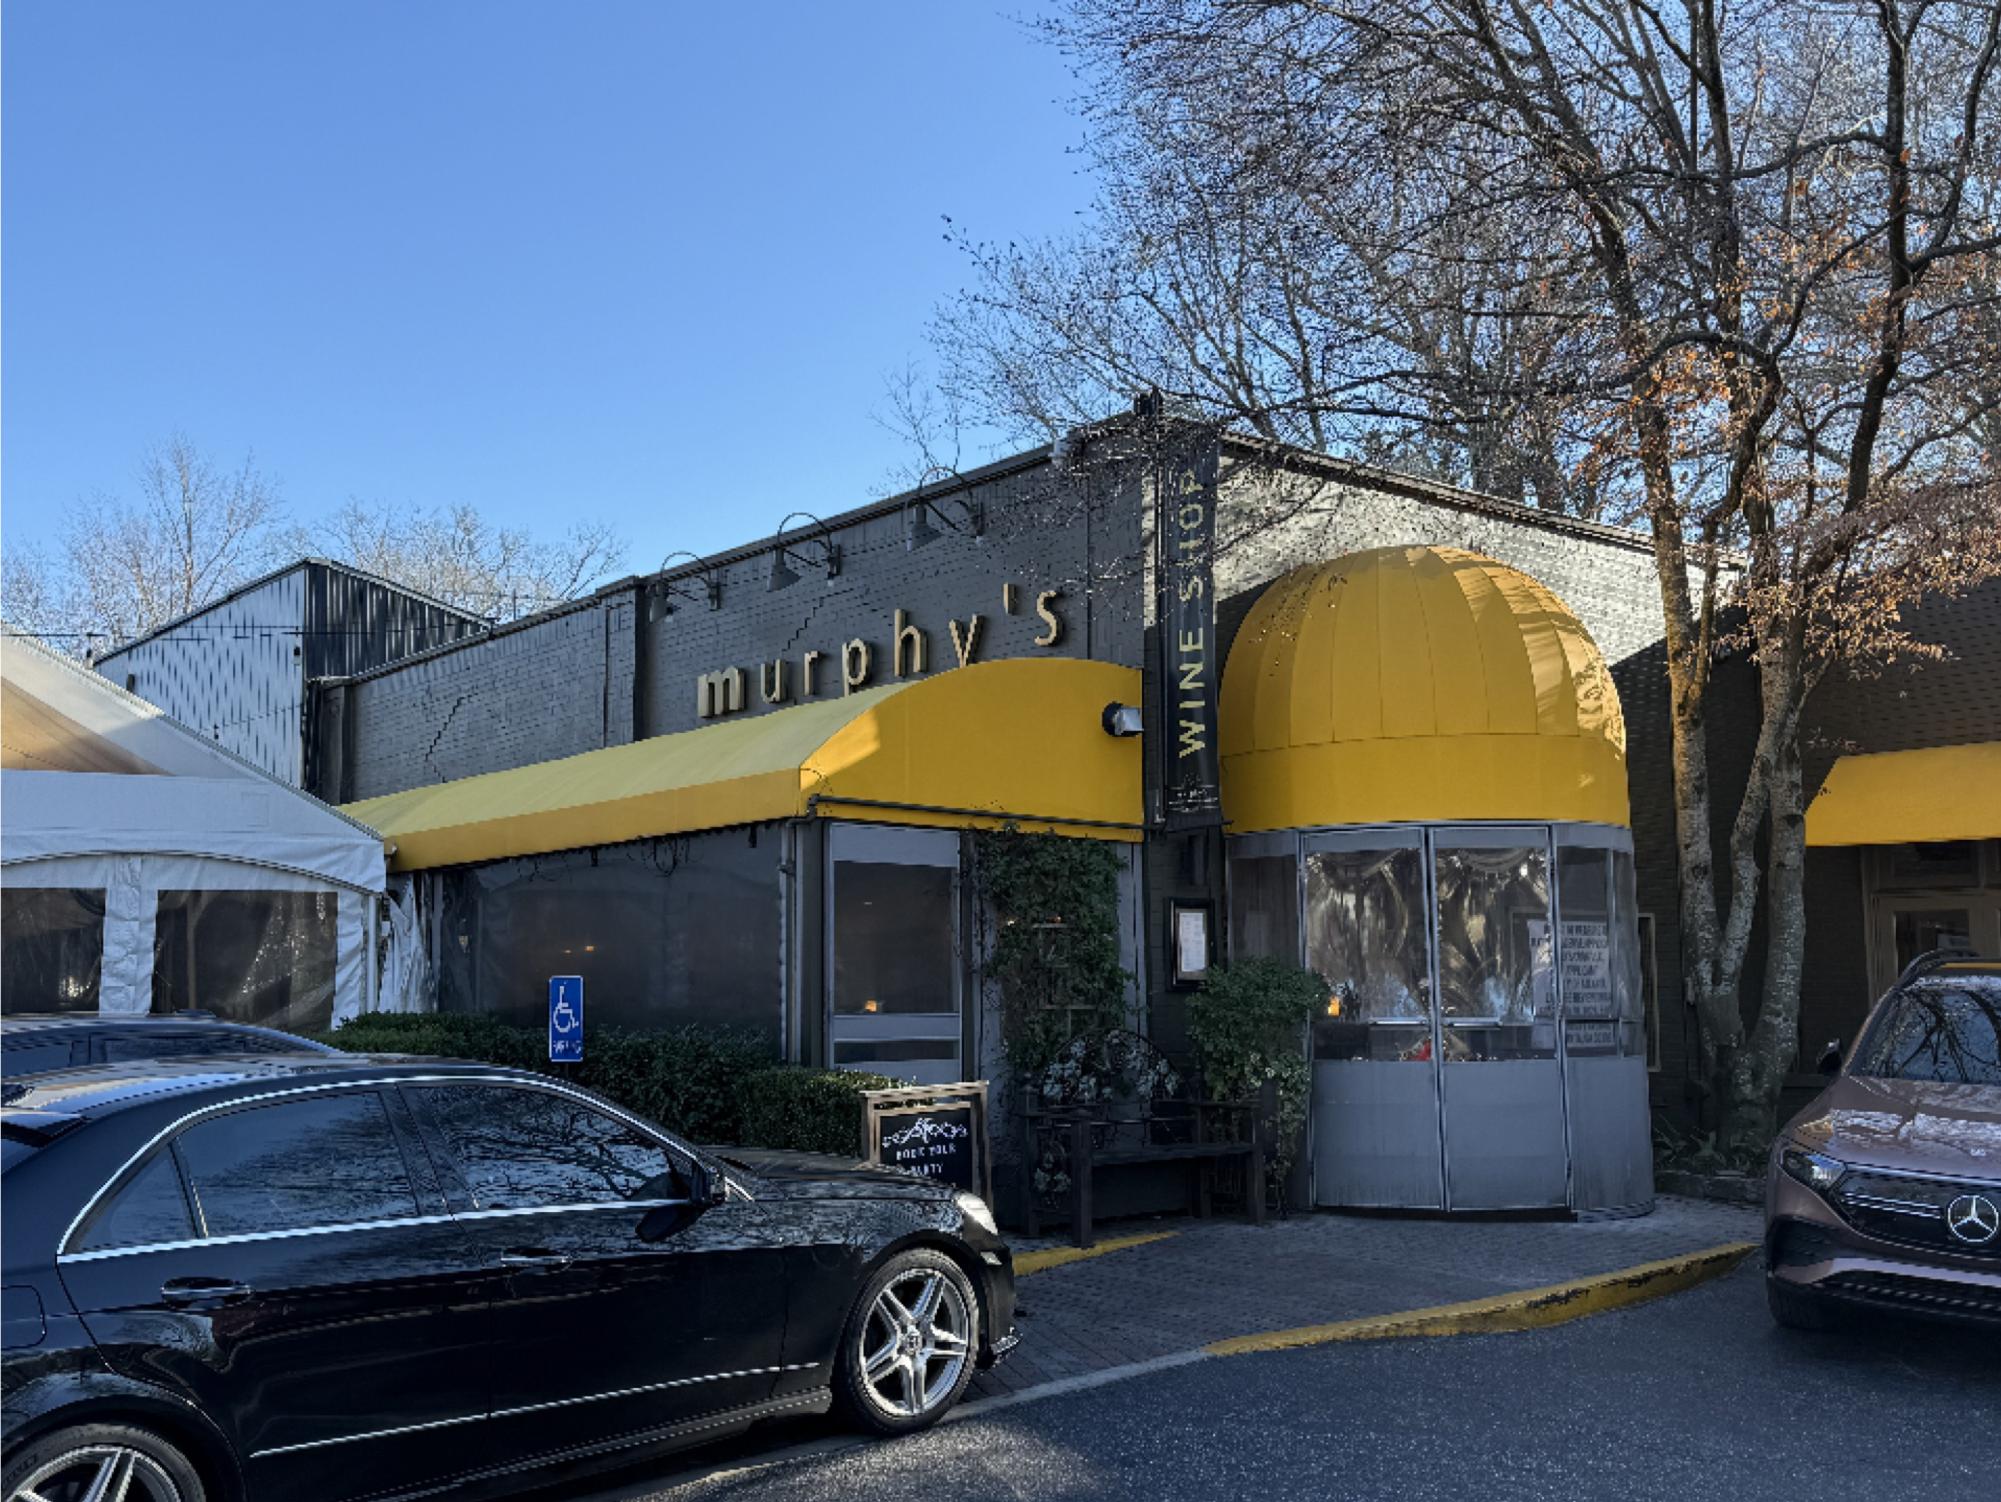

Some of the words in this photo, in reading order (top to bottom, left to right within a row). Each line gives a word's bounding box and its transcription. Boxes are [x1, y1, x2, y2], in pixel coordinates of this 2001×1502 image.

[1178, 469, 1205, 602] SHOP
[697, 582, 1060, 718] murphy's
[1178, 626, 1206, 759] WINE
